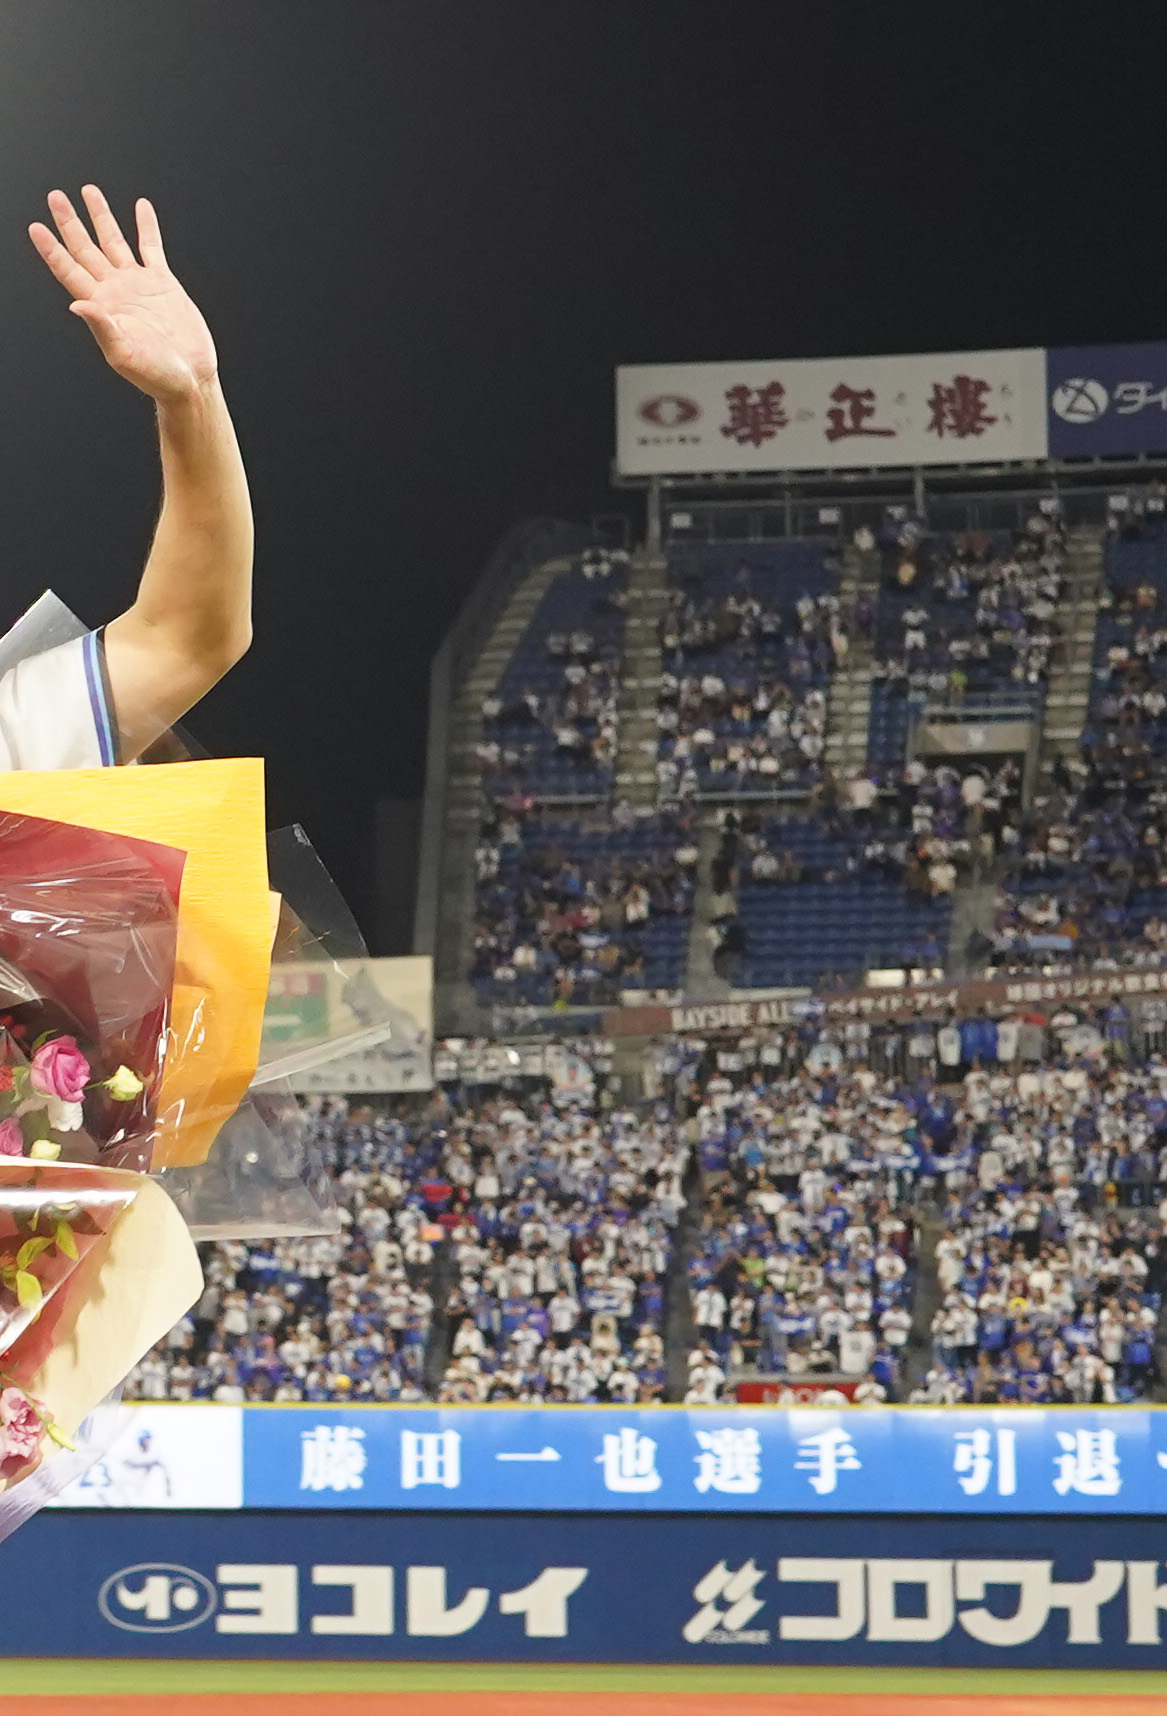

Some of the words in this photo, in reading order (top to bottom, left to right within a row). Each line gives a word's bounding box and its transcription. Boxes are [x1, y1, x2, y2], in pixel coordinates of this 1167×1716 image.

[671, 1002, 751, 1031] BAYSIDE
[299, 1424, 863, 1496] 藤田一也選手
[953, 1427, 1167, 1497] 引退
[216, 1563, 589, 1638] ヨコレイ
